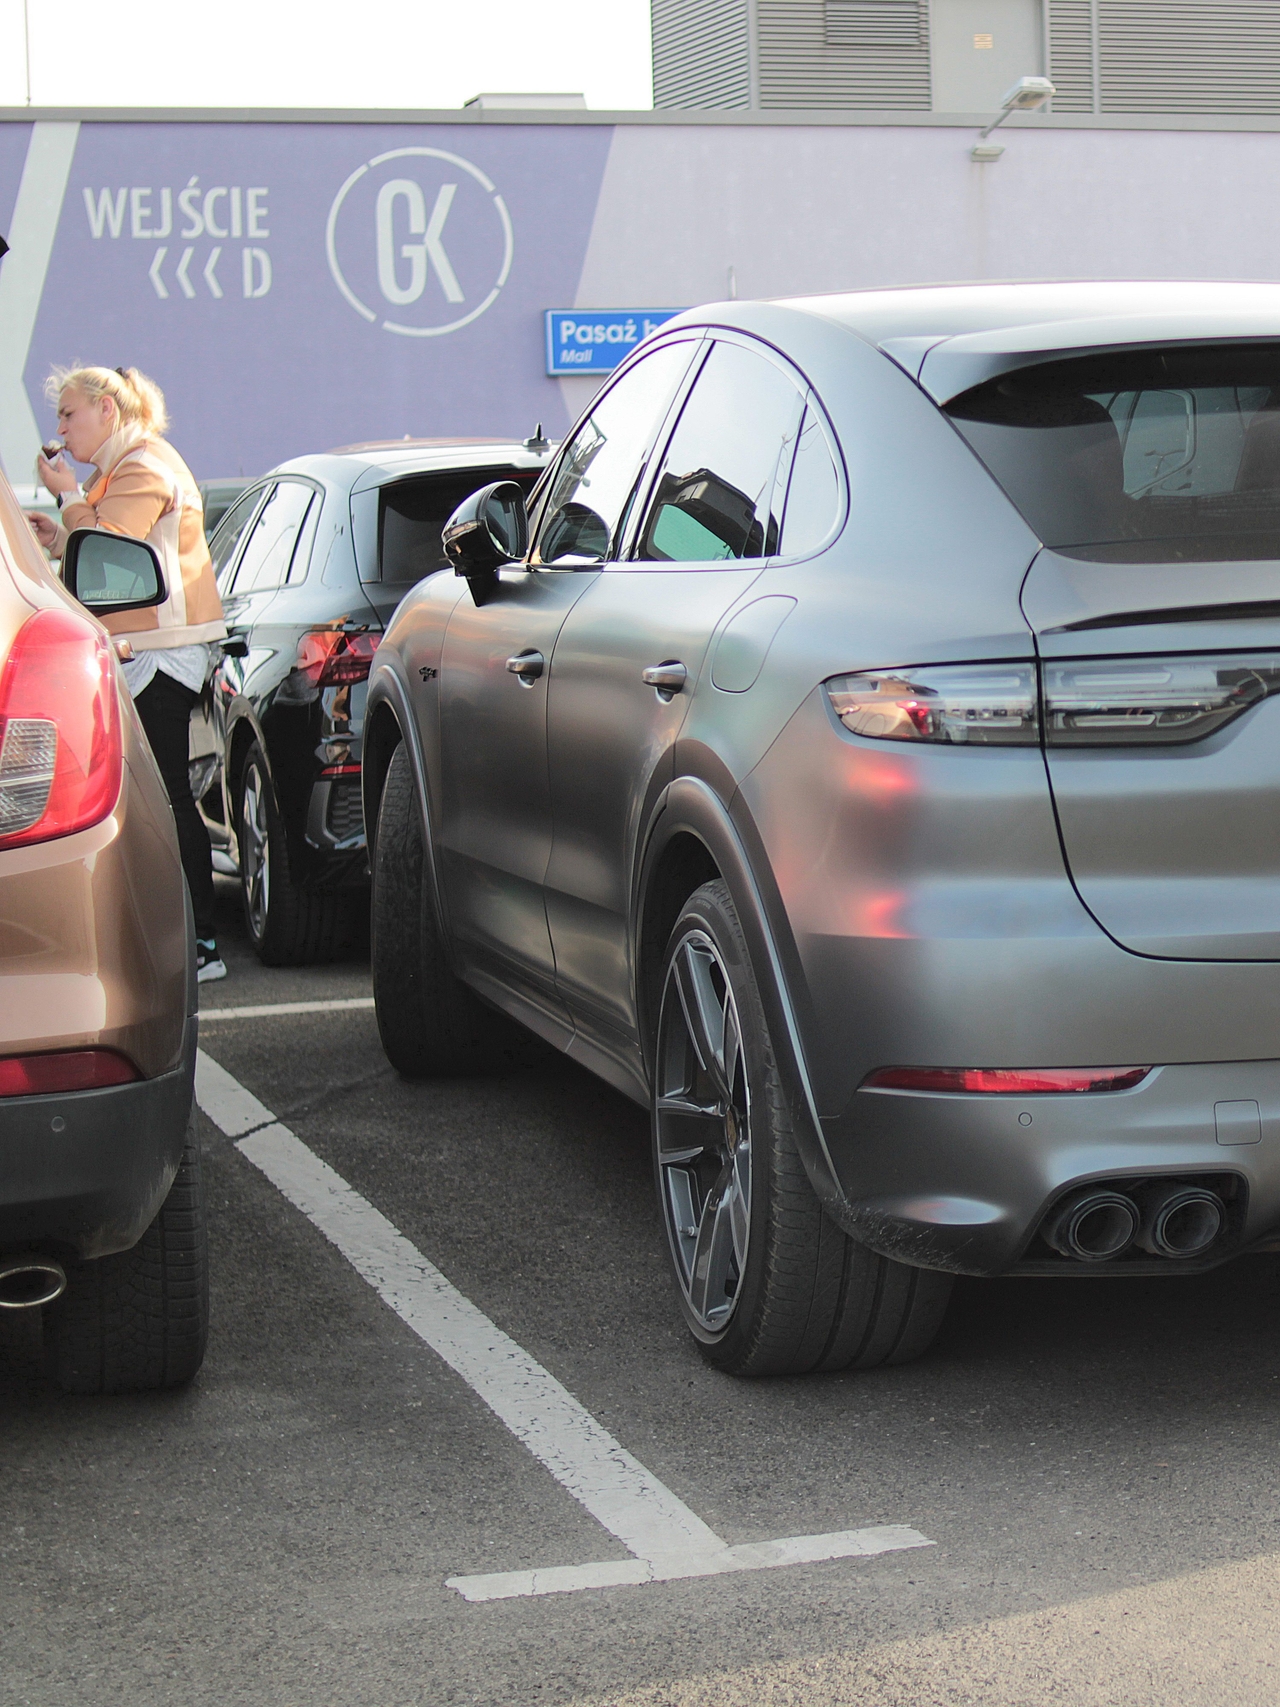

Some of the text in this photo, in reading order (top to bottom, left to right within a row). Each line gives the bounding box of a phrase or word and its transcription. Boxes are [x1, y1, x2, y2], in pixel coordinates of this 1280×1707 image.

[83, 175, 270, 239] WEJŚCIE
[375, 178, 466, 306] GK
[242, 246, 273, 299] D
[560, 318, 638, 345] Pasaż
[560, 349, 593, 364] Mall
